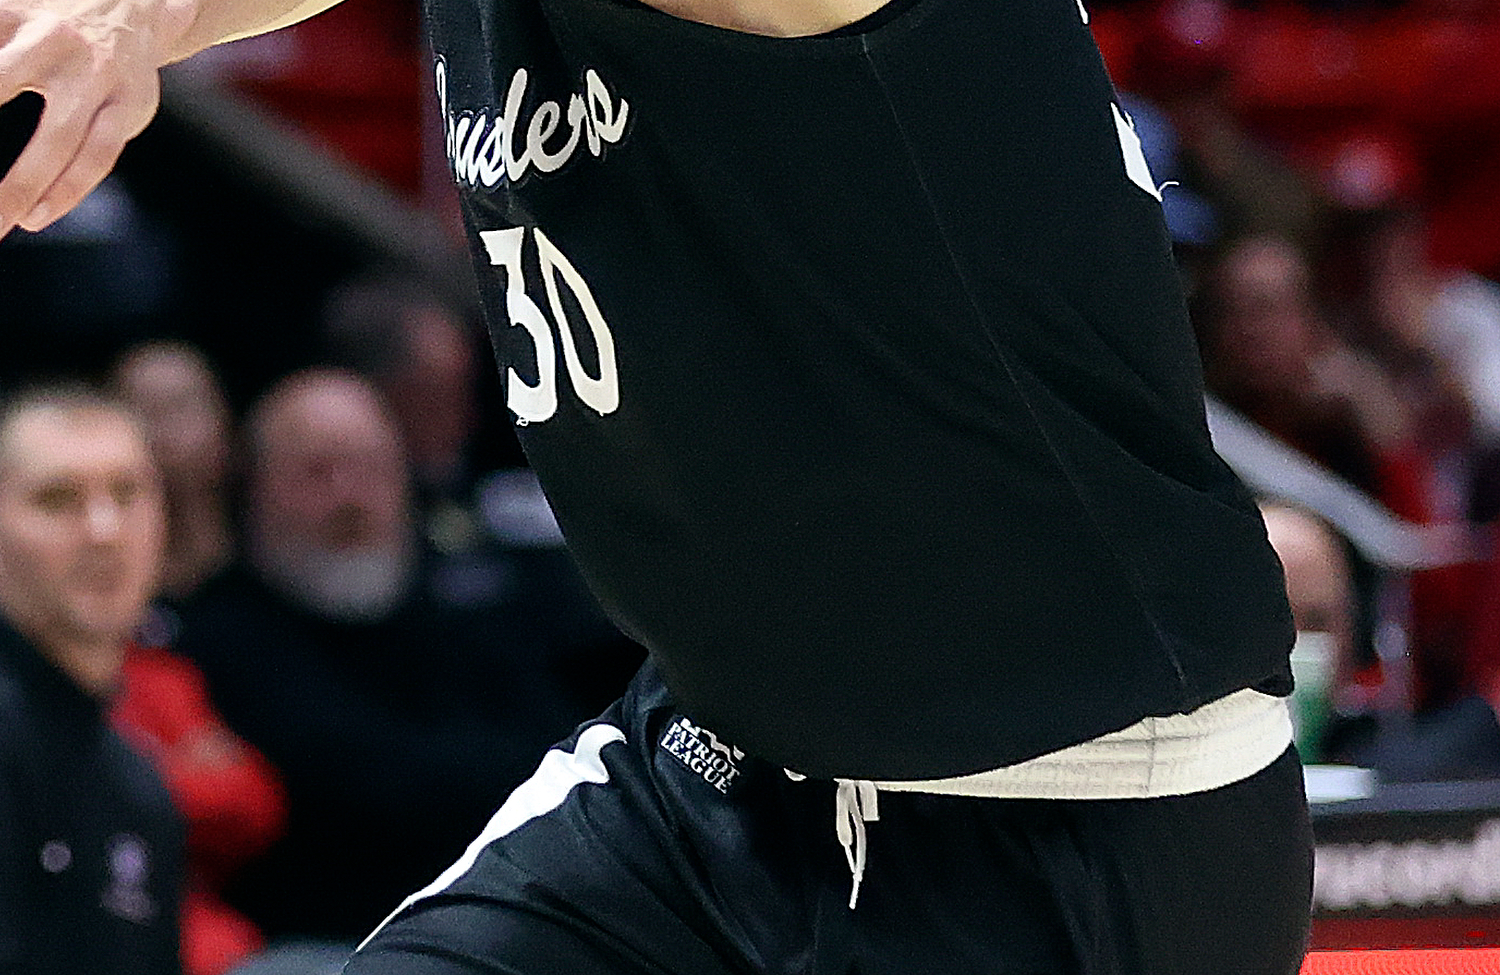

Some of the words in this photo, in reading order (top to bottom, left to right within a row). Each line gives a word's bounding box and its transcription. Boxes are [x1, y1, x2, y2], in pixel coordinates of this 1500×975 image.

[479, 226, 620, 426] 30
[660, 733, 727, 795] LEAGUE
[668, 722, 741, 787] PATRIOT
